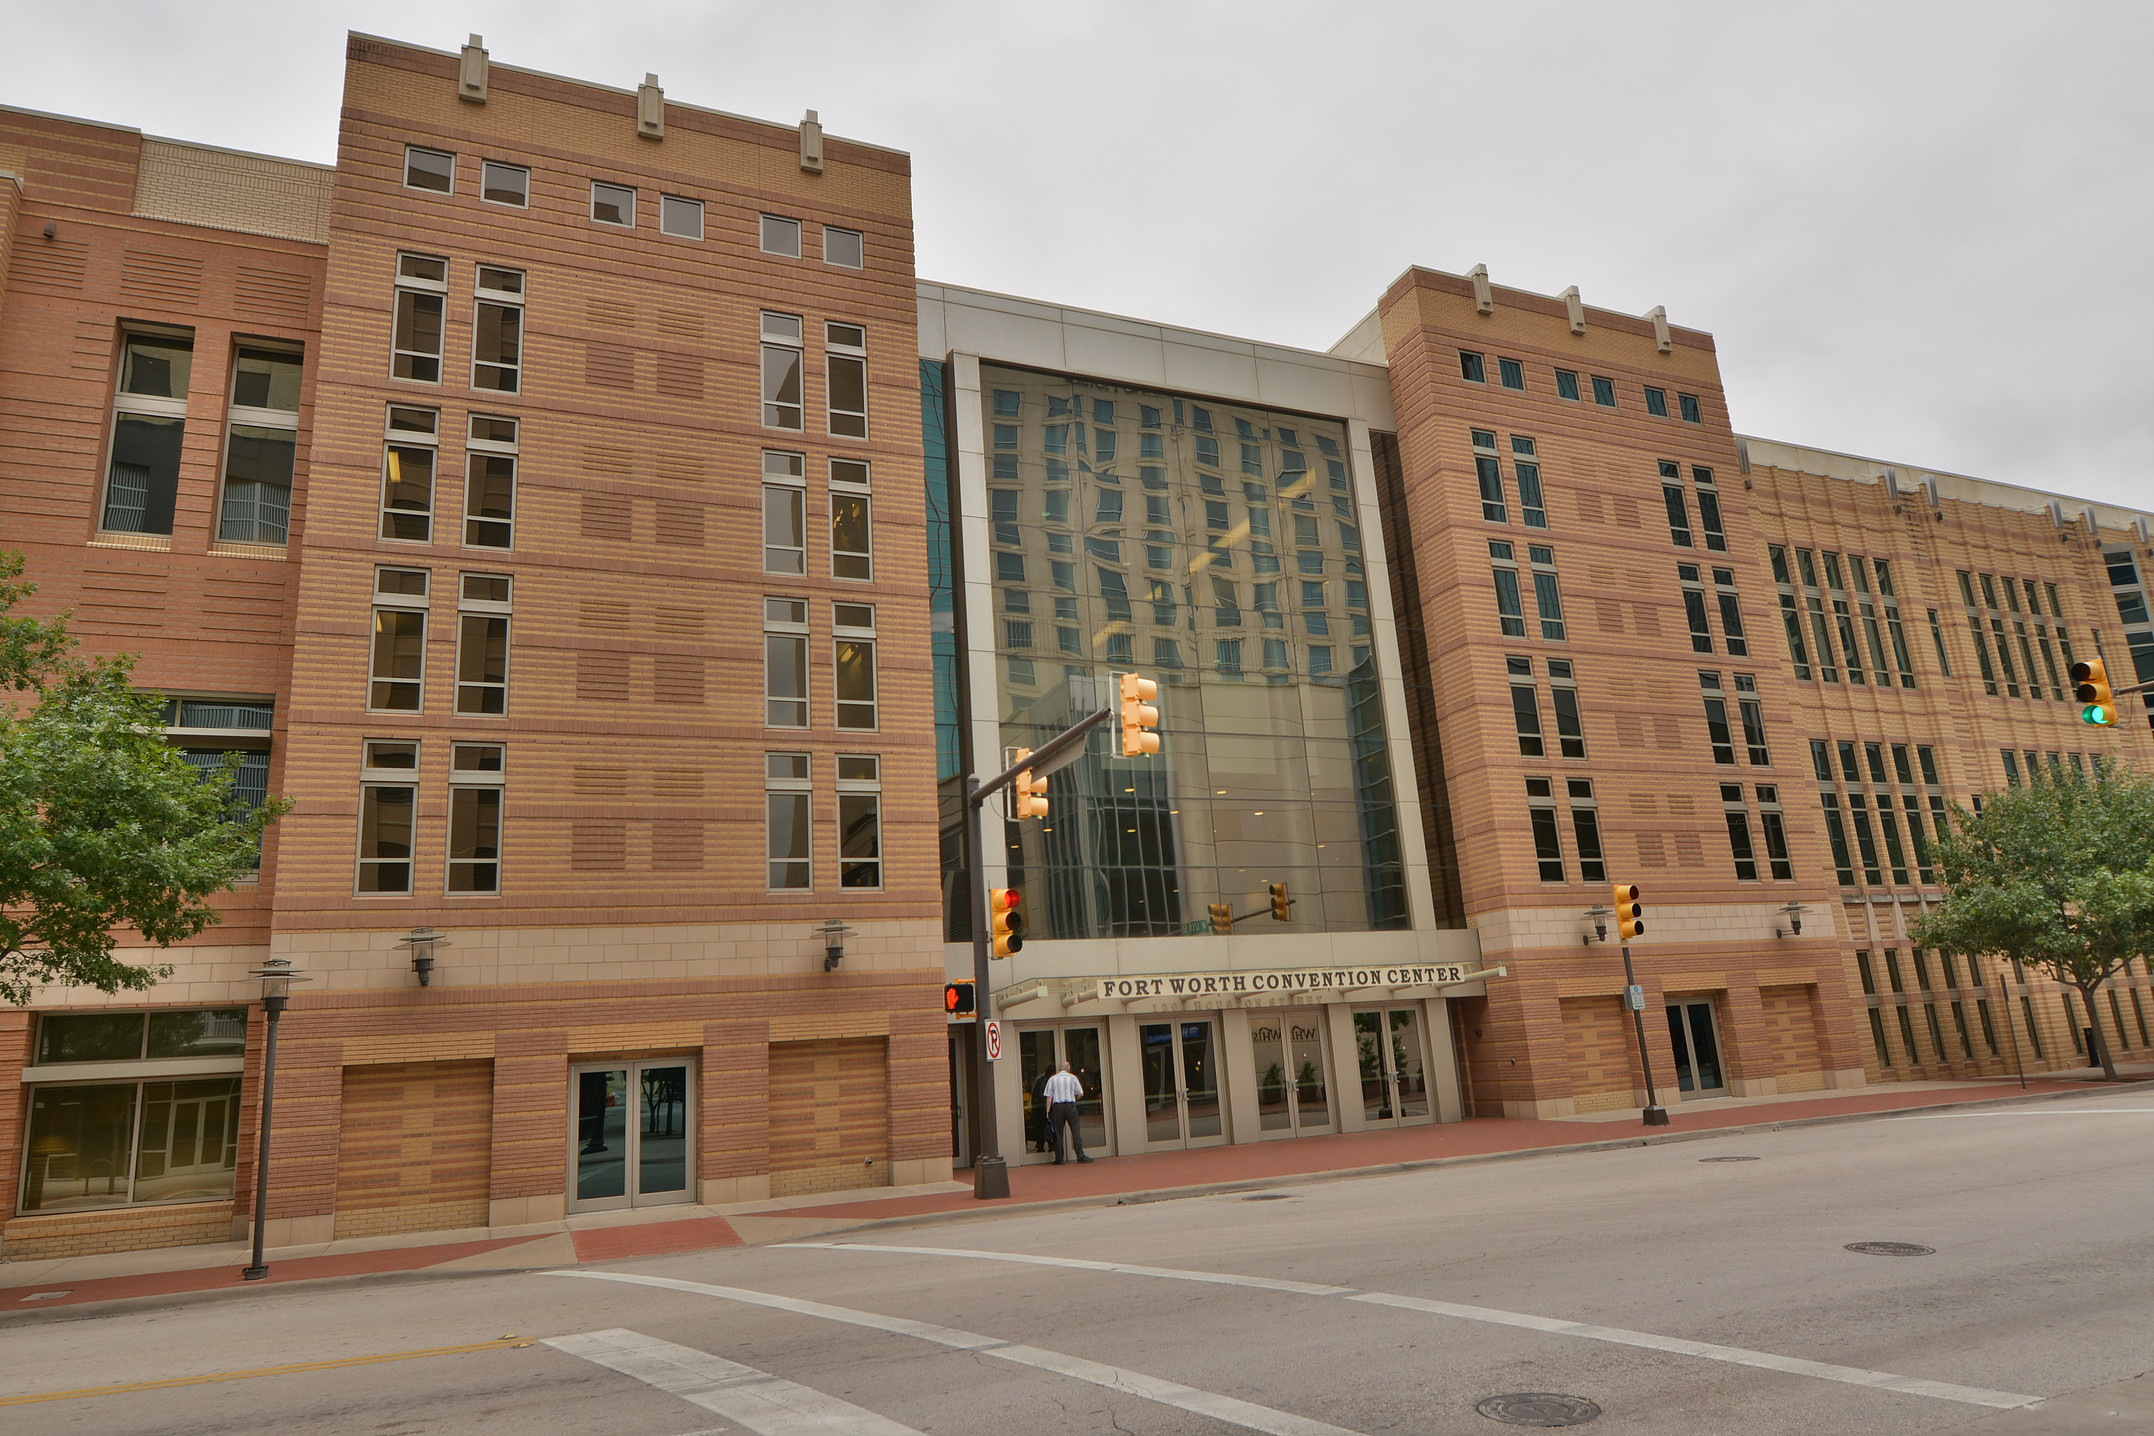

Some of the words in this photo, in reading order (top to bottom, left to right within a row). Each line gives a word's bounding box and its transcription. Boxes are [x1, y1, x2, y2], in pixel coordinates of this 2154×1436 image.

[1103, 979, 1163, 997] FORT
[1169, 976, 1246, 994] WORTH
[1252, 970, 1381, 990] CONVENTION
[1387, 967, 1461, 984] CENTER
[1194, 999, 1261, 1011] HOUSTON
[1269, 995, 1322, 1007] STREET
